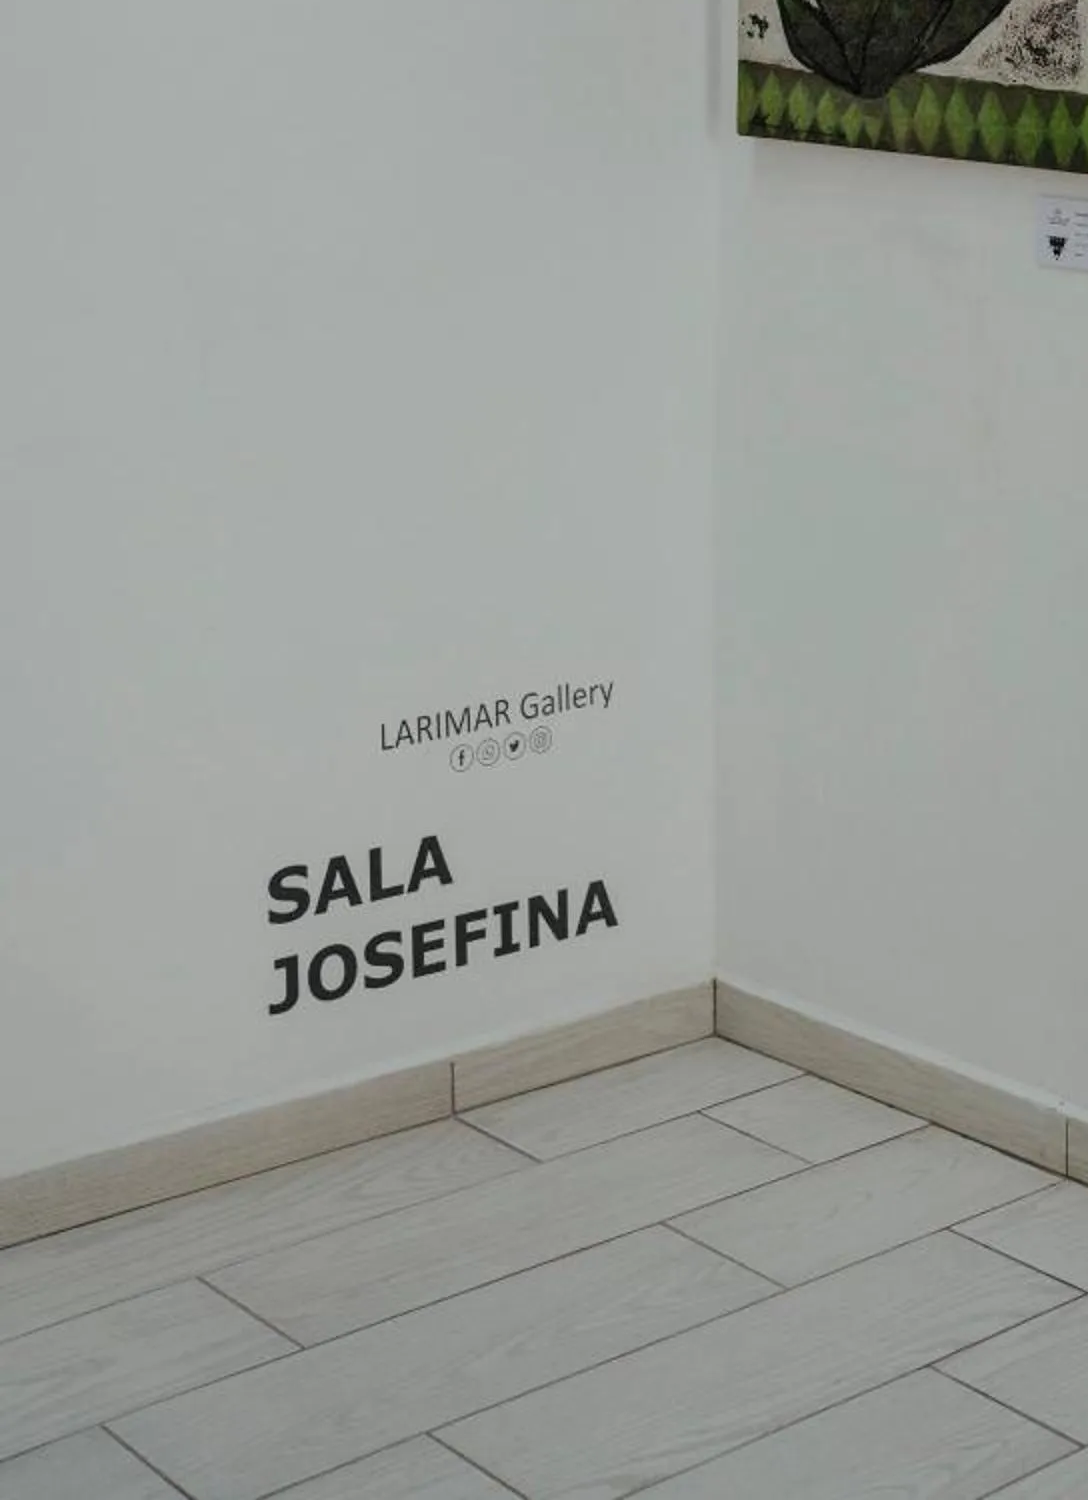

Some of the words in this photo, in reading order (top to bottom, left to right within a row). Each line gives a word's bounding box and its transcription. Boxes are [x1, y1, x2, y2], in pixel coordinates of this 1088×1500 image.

[380, 698, 512, 752] LARIMAR
[519, 681, 615, 720] Gallery
[267, 835, 454, 925] SALA
[268, 879, 620, 1016] JOSEFINA
